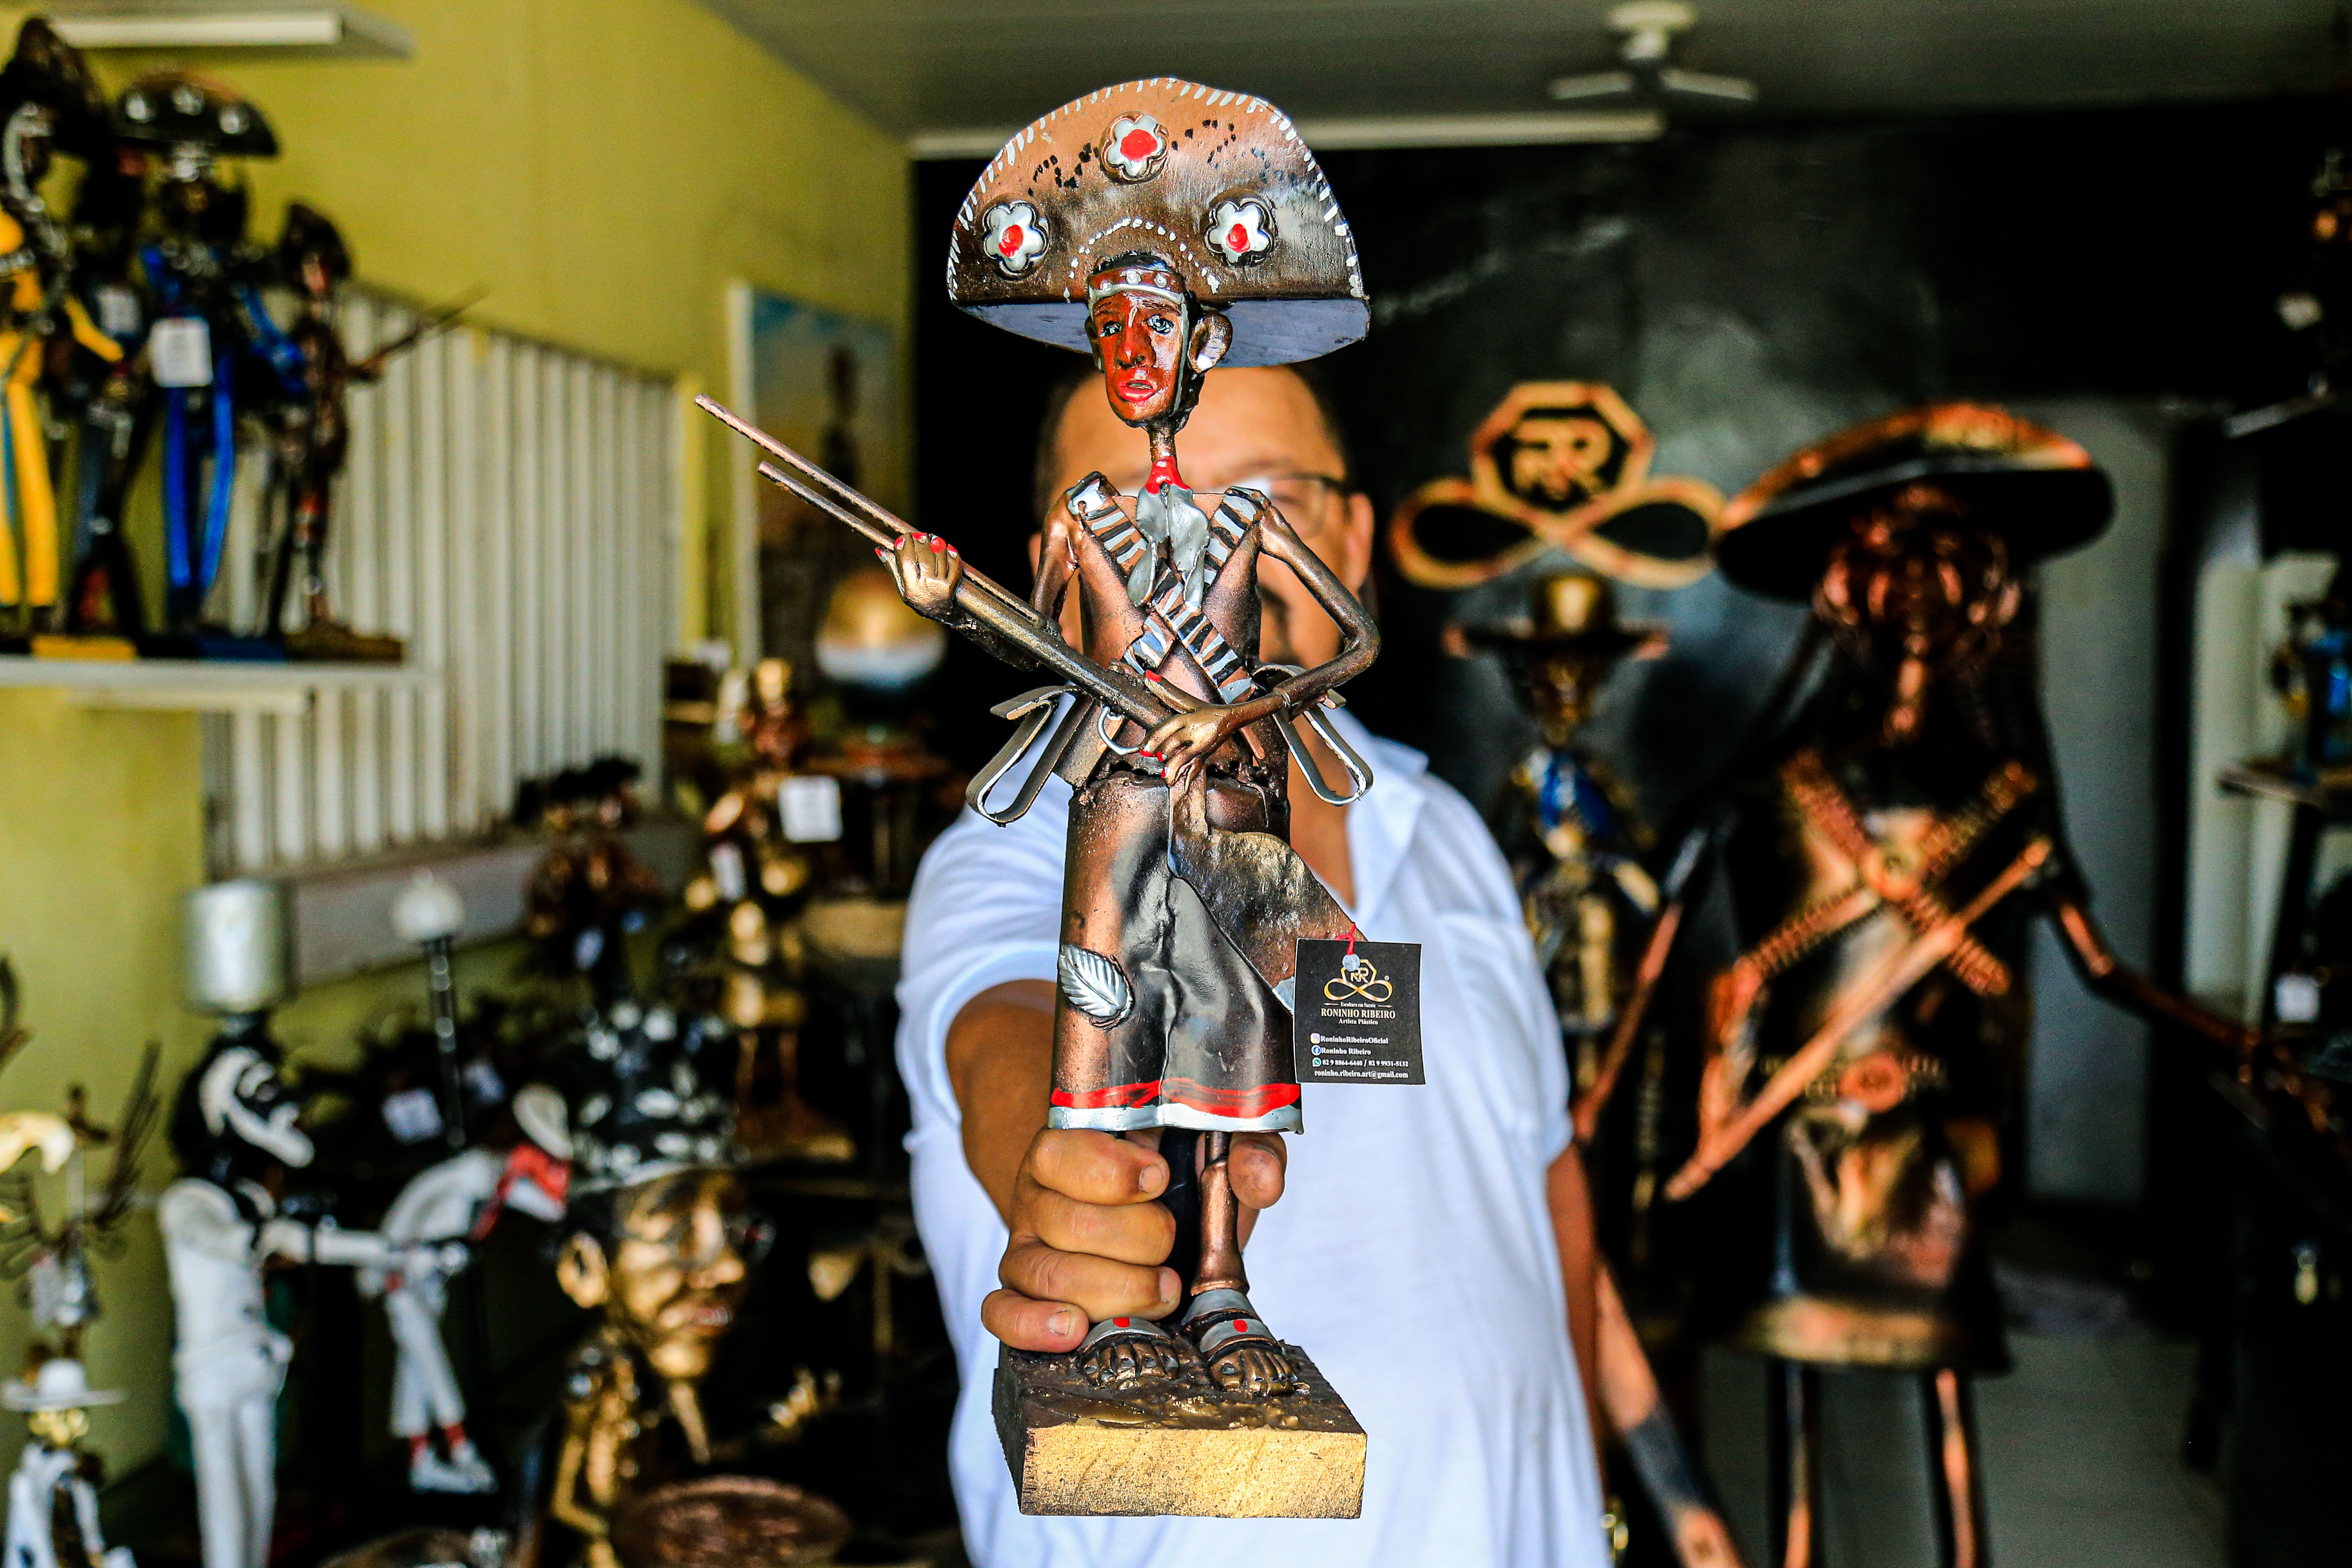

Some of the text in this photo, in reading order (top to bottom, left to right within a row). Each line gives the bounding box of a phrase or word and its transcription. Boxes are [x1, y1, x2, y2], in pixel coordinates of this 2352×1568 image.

[1321, 1008, 1396, 1019] RONINHO RIBEIRO
[1321, 1035, 1389, 1044] RoninhoRibeiroOficial
[1314, 1069, 1409, 1079] roninho.ribeiro.art@gmail.com
